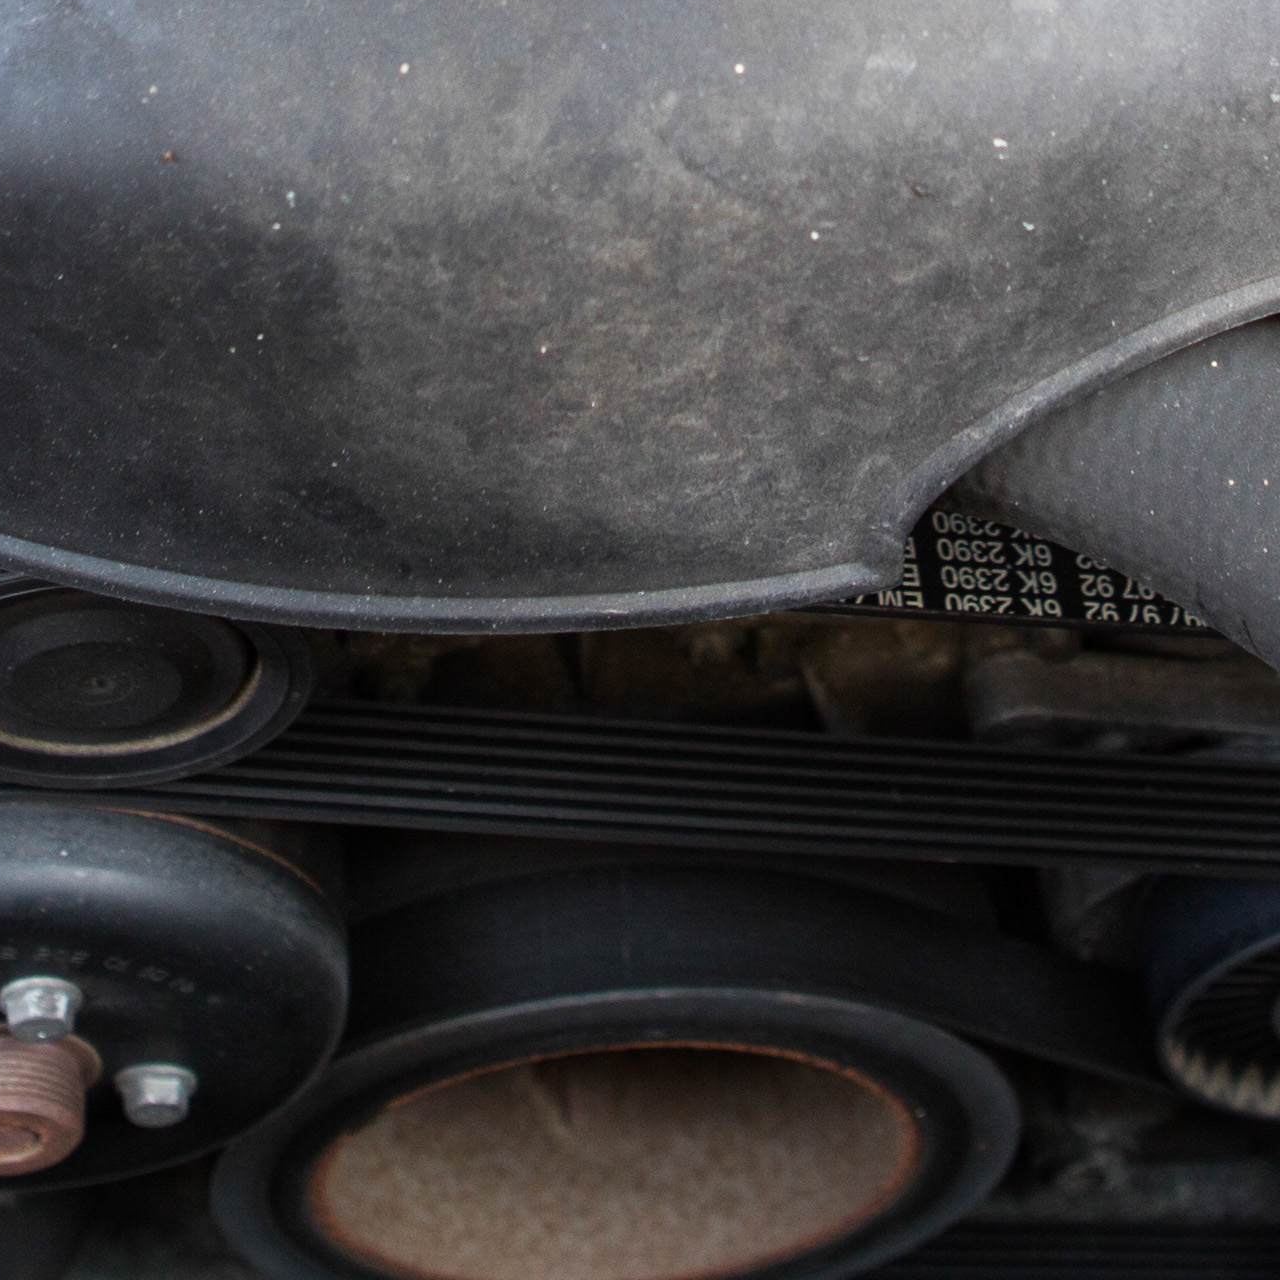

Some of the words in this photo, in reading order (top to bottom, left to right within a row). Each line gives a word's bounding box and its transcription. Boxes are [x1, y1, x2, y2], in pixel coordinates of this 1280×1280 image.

[937, 537, 1007, 564] 2390
[1019, 543, 1053, 566] 6K
[940, 564, 1012, 592] 2390
[1020, 570, 1058, 595] 6K
[1080, 573, 1115, 599] 92
[945, 591, 1016, 616] 2390
[1022, 597, 1064, 618] 6K
[1083, 600, 1119, 623] 92
